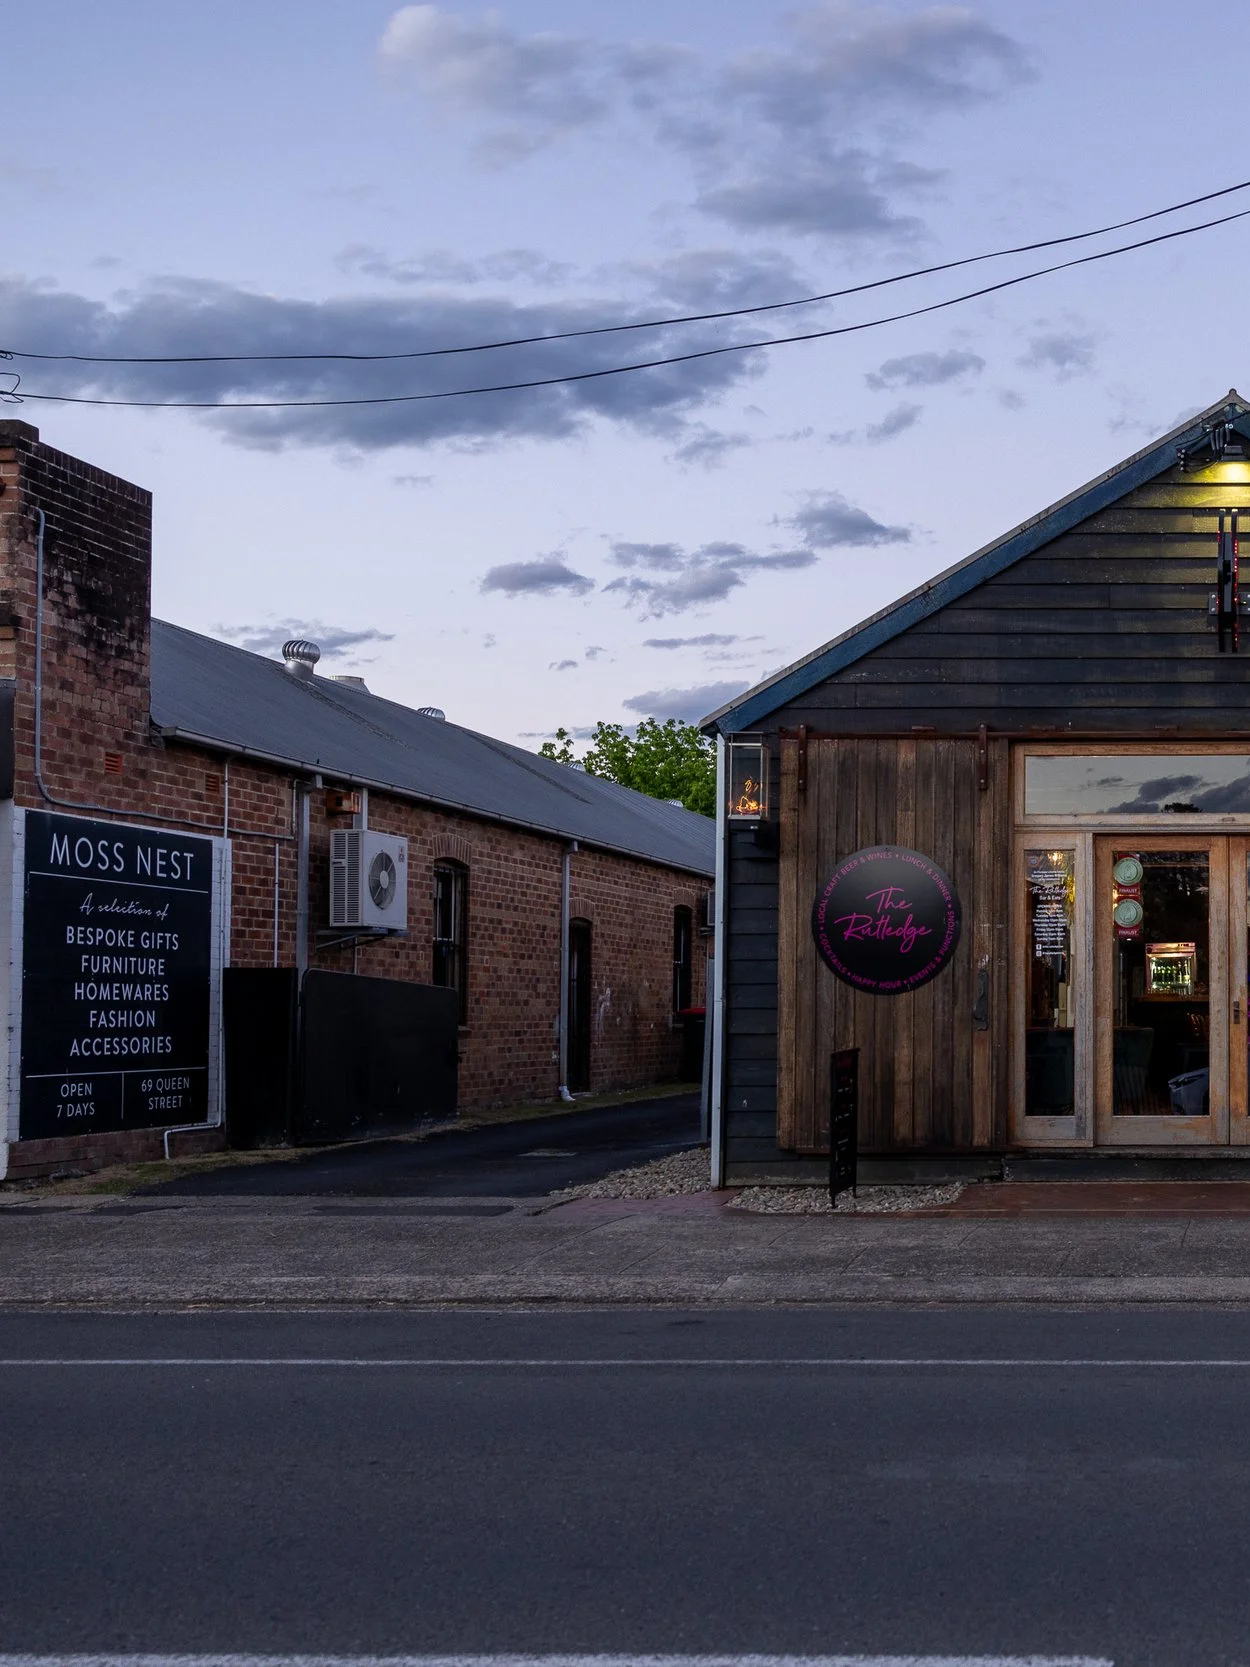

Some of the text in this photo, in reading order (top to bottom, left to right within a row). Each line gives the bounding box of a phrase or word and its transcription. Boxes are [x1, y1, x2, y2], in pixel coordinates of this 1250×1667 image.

[50, 832, 195, 881] MOSS NEST
[816, 898, 829, 924] LOCAL
[824, 874, 842, 898] CRAFT
[840, 860, 860, 876] BEER
[866, 852, 893, 862] WINES
[901, 853, 927, 870] LUNCH
[931, 873, 952, 902] DINNER
[79, 892, 170, 920] A selection of
[865, 885, 913, 914] The
[66, 926, 180, 951] BESPOKE GIFTS
[833, 912, 933, 954] Rutledge
[819, 934, 848, 975] COCKTAILS
[909, 962, 937, 984] EVENTS
[940, 910, 956, 956] FUNCTIONS
[81, 954, 166, 977] FURNITURE
[74, 982, 170, 1002] HOMEWARES
[850, 973, 902, 989] HAPPY HOUR
[89, 1010, 156, 1028] FASHION
[70, 1036, 172, 1057] ACCESSORIES
[60, 1082, 93, 1098] OPEN
[140, 1076, 190, 1094] 69 QUEEN
[56, 1101, 96, 1118] 7 DAYS
[148, 1095, 182, 1111] STREET
